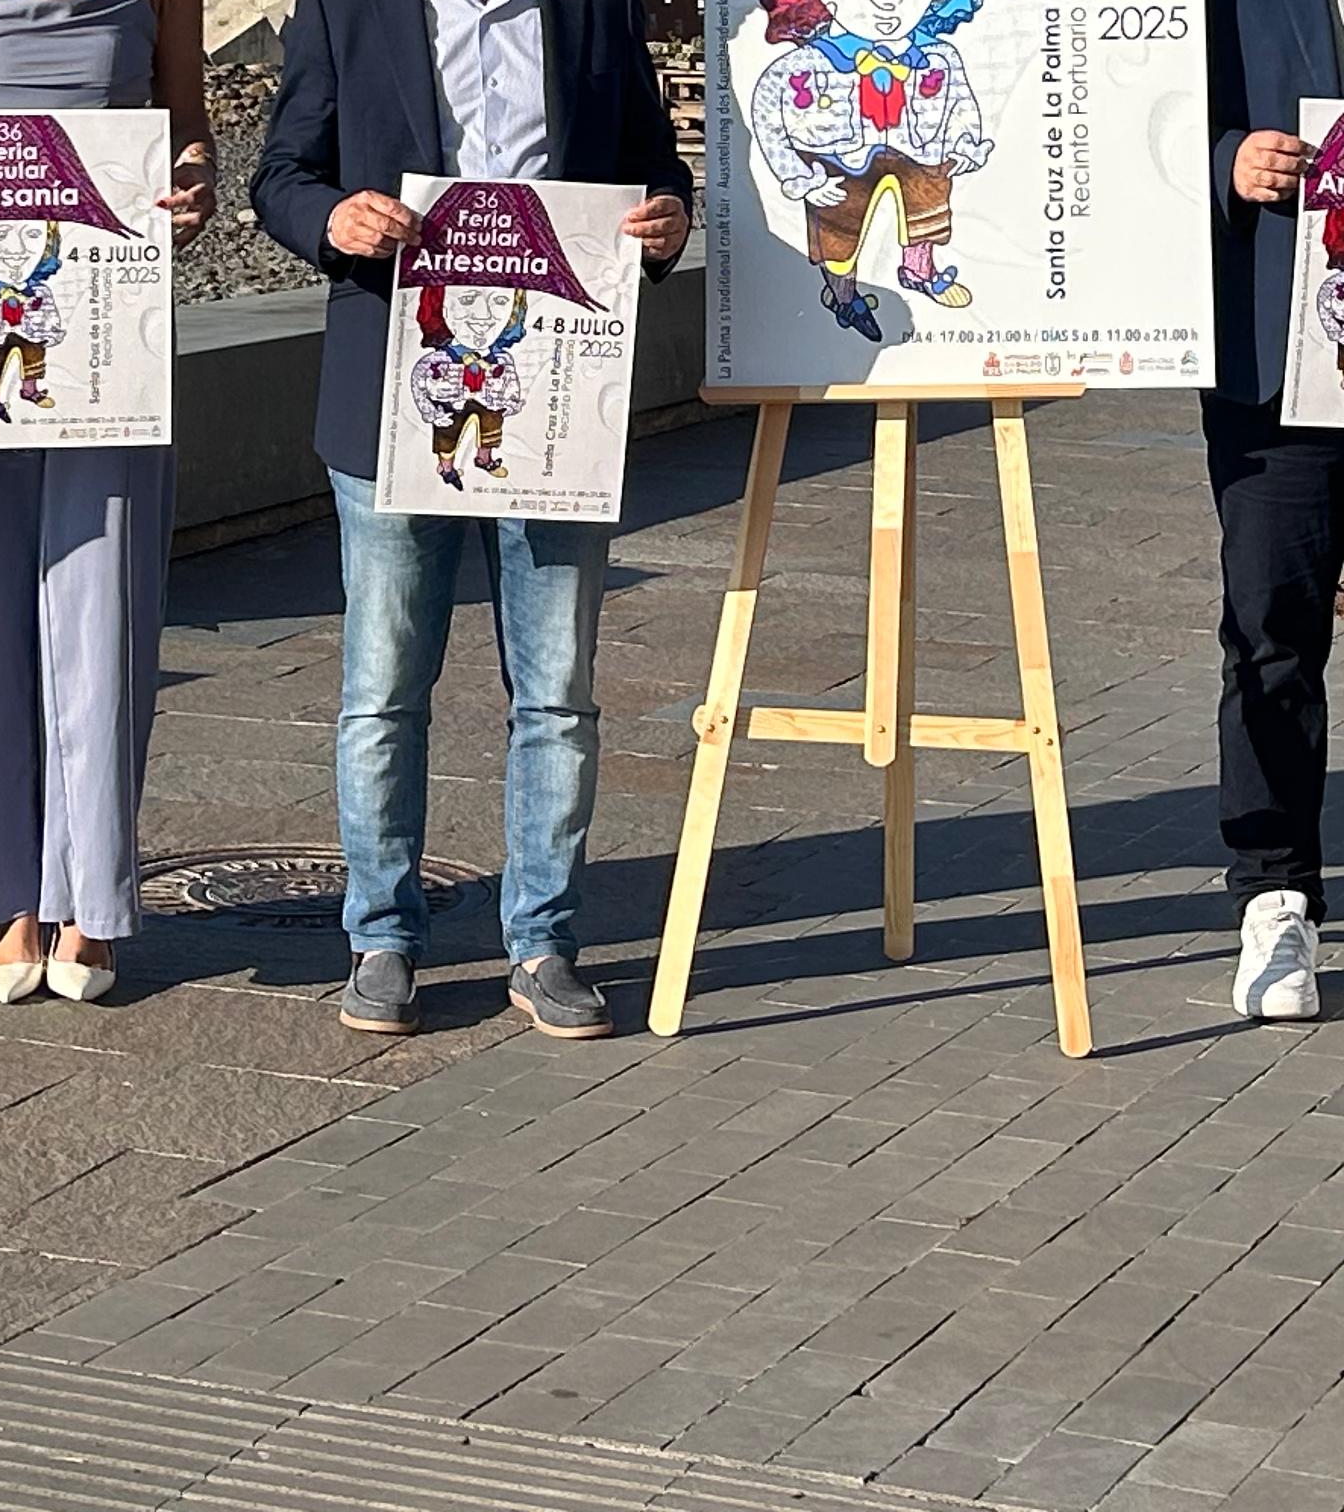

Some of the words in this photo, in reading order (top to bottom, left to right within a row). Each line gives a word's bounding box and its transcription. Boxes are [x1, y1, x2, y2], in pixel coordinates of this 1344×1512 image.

[1098, 6, 1188, 40] 2025
[1040, 8, 1061, 82] Palma
[1066, 7, 1088, 115] Portuario
[717, 94, 730, 114] des
[1042, 92, 1062, 117] La
[1042, 127, 1063, 159] de
[717, 118, 733, 188] Ausstellung
[1068, 124, 1091, 217] Recinto
[475, 190, 498, 208] 36
[1044, 167, 1064, 221] Cruz
[716, 199, 730, 217] fair
[458, 209, 512, 228] Feria
[446, 228, 521, 247] Insular
[716, 220, 730, 246] craft
[106, 245, 160, 262] JULIO
[412, 248, 549, 275] Artesanía
[1045, 230, 1066, 299] Santa
[116, 266, 160, 284] 2025
[717, 250, 731, 312] traditional
[89, 307, 100, 320] La
[89, 324, 100, 339] de
[569, 318, 624, 336] JULIO
[940, 330, 974, 343] 17.00
[987, 330, 1021, 343] 21.00
[1107, 329, 1141, 341] 11.00
[1153, 329, 1188, 341] 21.00
[579, 339, 623, 358] 2025
[718, 367, 731, 379] La
[549, 378, 560, 392] La
[548, 395, 559, 411] de
